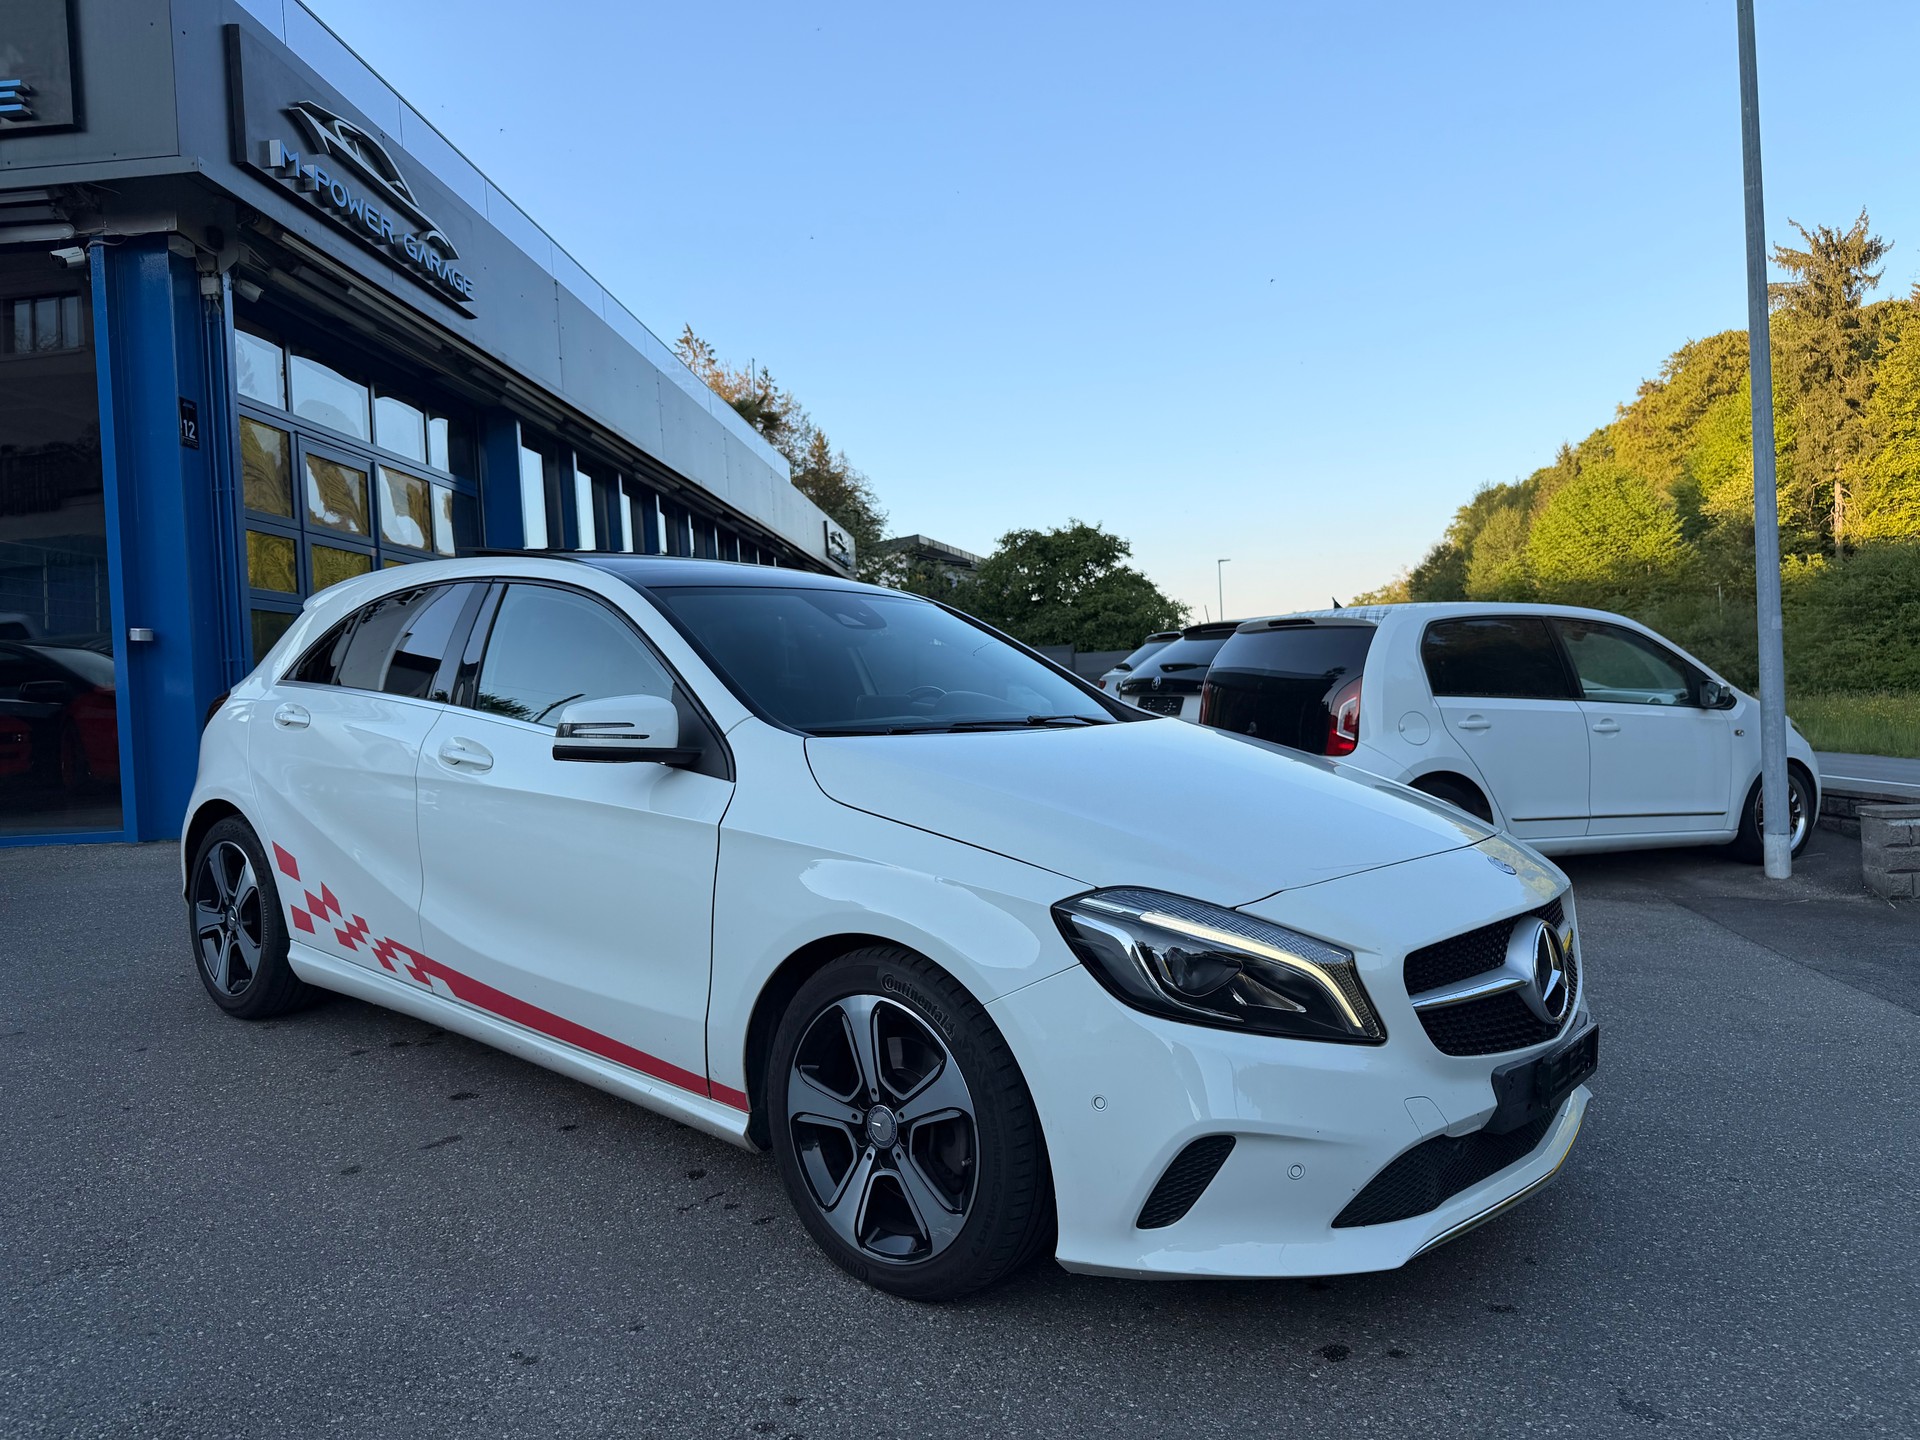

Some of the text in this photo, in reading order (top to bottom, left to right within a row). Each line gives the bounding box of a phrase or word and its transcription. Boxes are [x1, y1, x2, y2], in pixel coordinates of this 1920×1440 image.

[277, 140, 475, 302] M-POWER GARAGE
[183, 419, 196, 439] 12
[881, 973, 952, 1033] Continental
